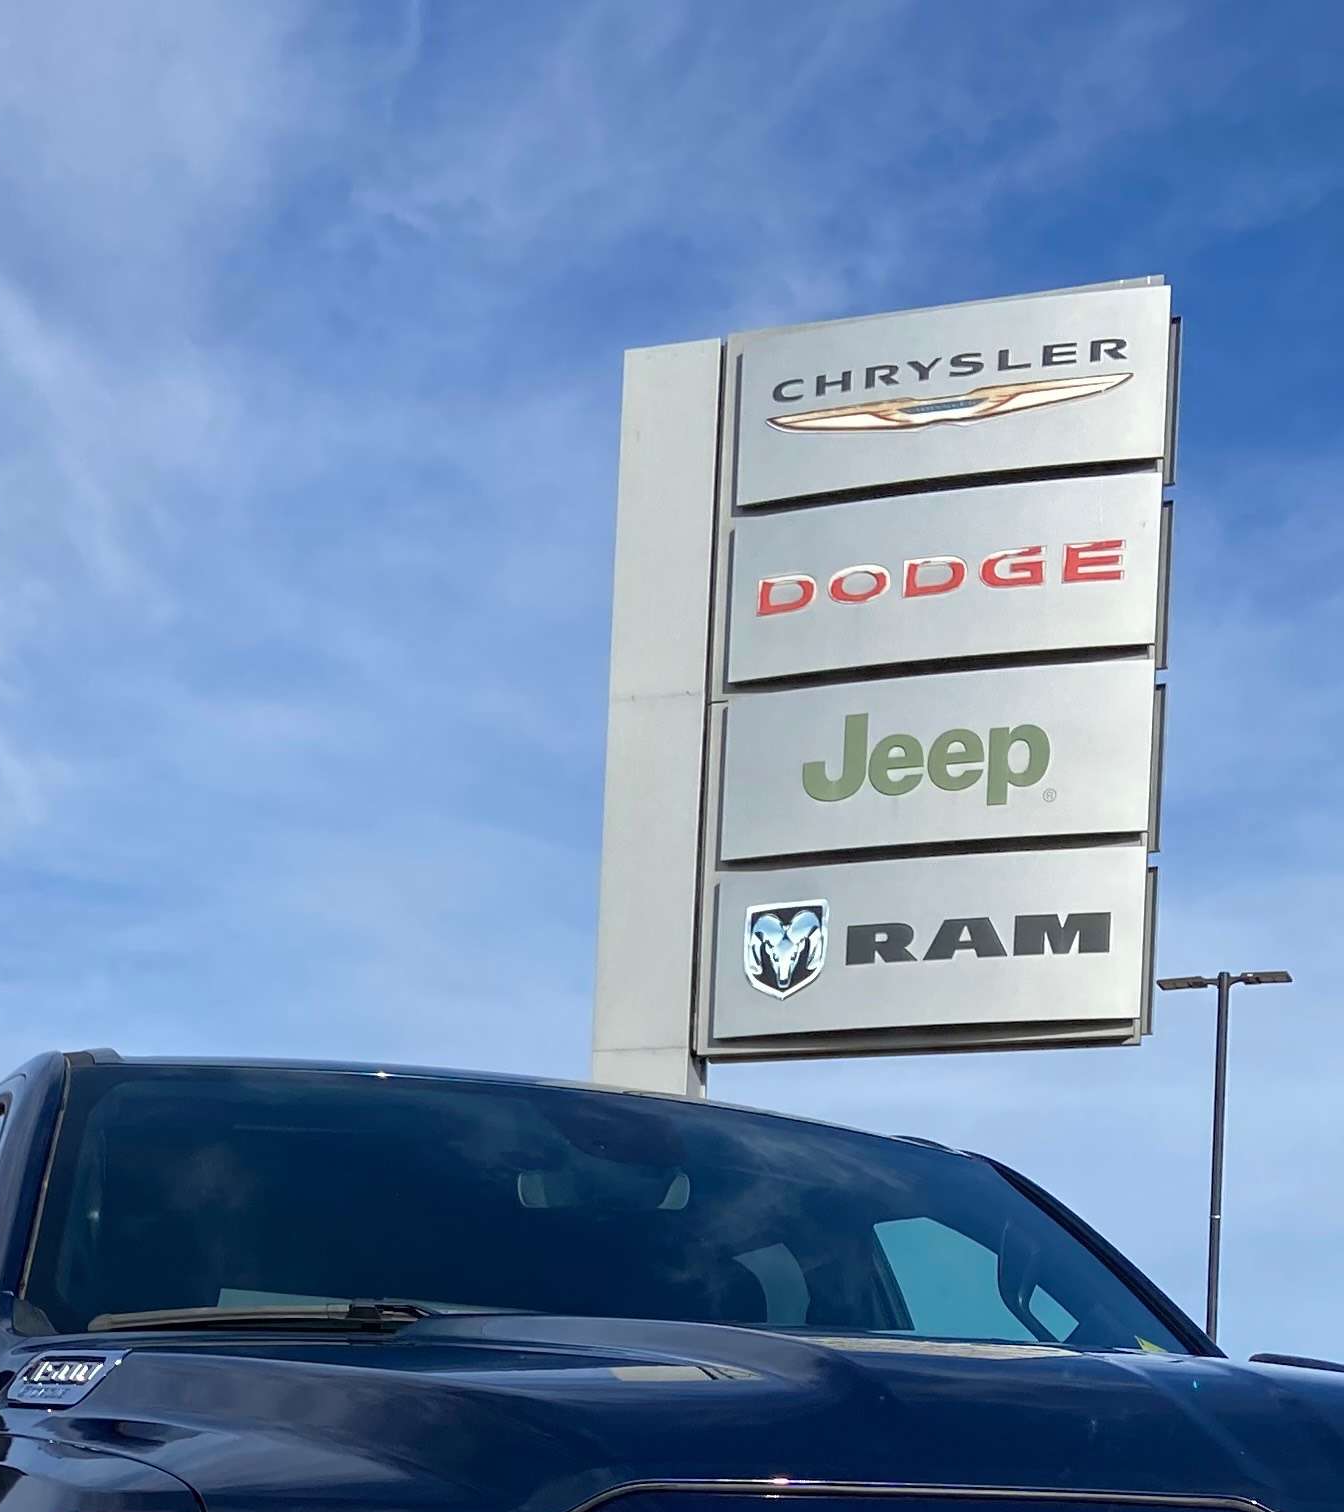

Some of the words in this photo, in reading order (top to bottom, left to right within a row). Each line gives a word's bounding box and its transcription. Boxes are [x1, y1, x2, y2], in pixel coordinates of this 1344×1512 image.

[772, 338, 1128, 403] CHRYSLER
[756, 539, 1126, 617] DODGE
[803, 713, 1050, 806] Jeep
[845, 912, 1111, 965] RAM
